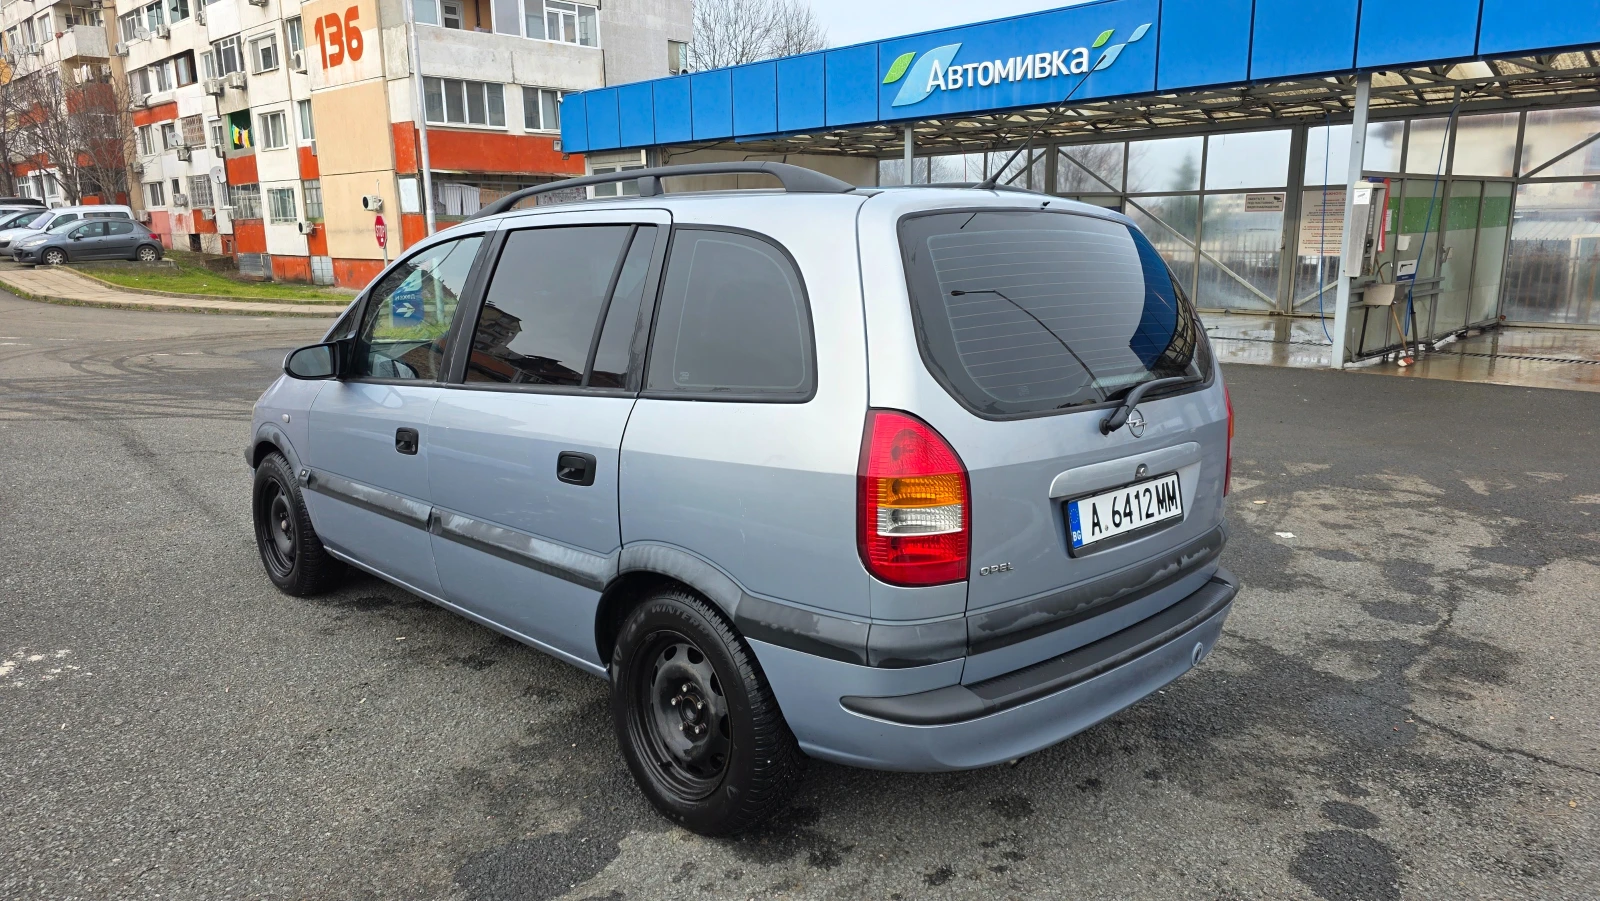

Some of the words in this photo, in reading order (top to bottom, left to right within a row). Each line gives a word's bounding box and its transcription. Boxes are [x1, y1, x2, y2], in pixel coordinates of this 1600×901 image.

[314, 5, 363, 69] 136
[926, 47, 1089, 92] Автомивка
[376, 225, 384, 237] STOP
[1112, 488, 1154, 528] 6412
[1073, 531, 1082, 541] BG
[980, 562, 1014, 576] OPEL
